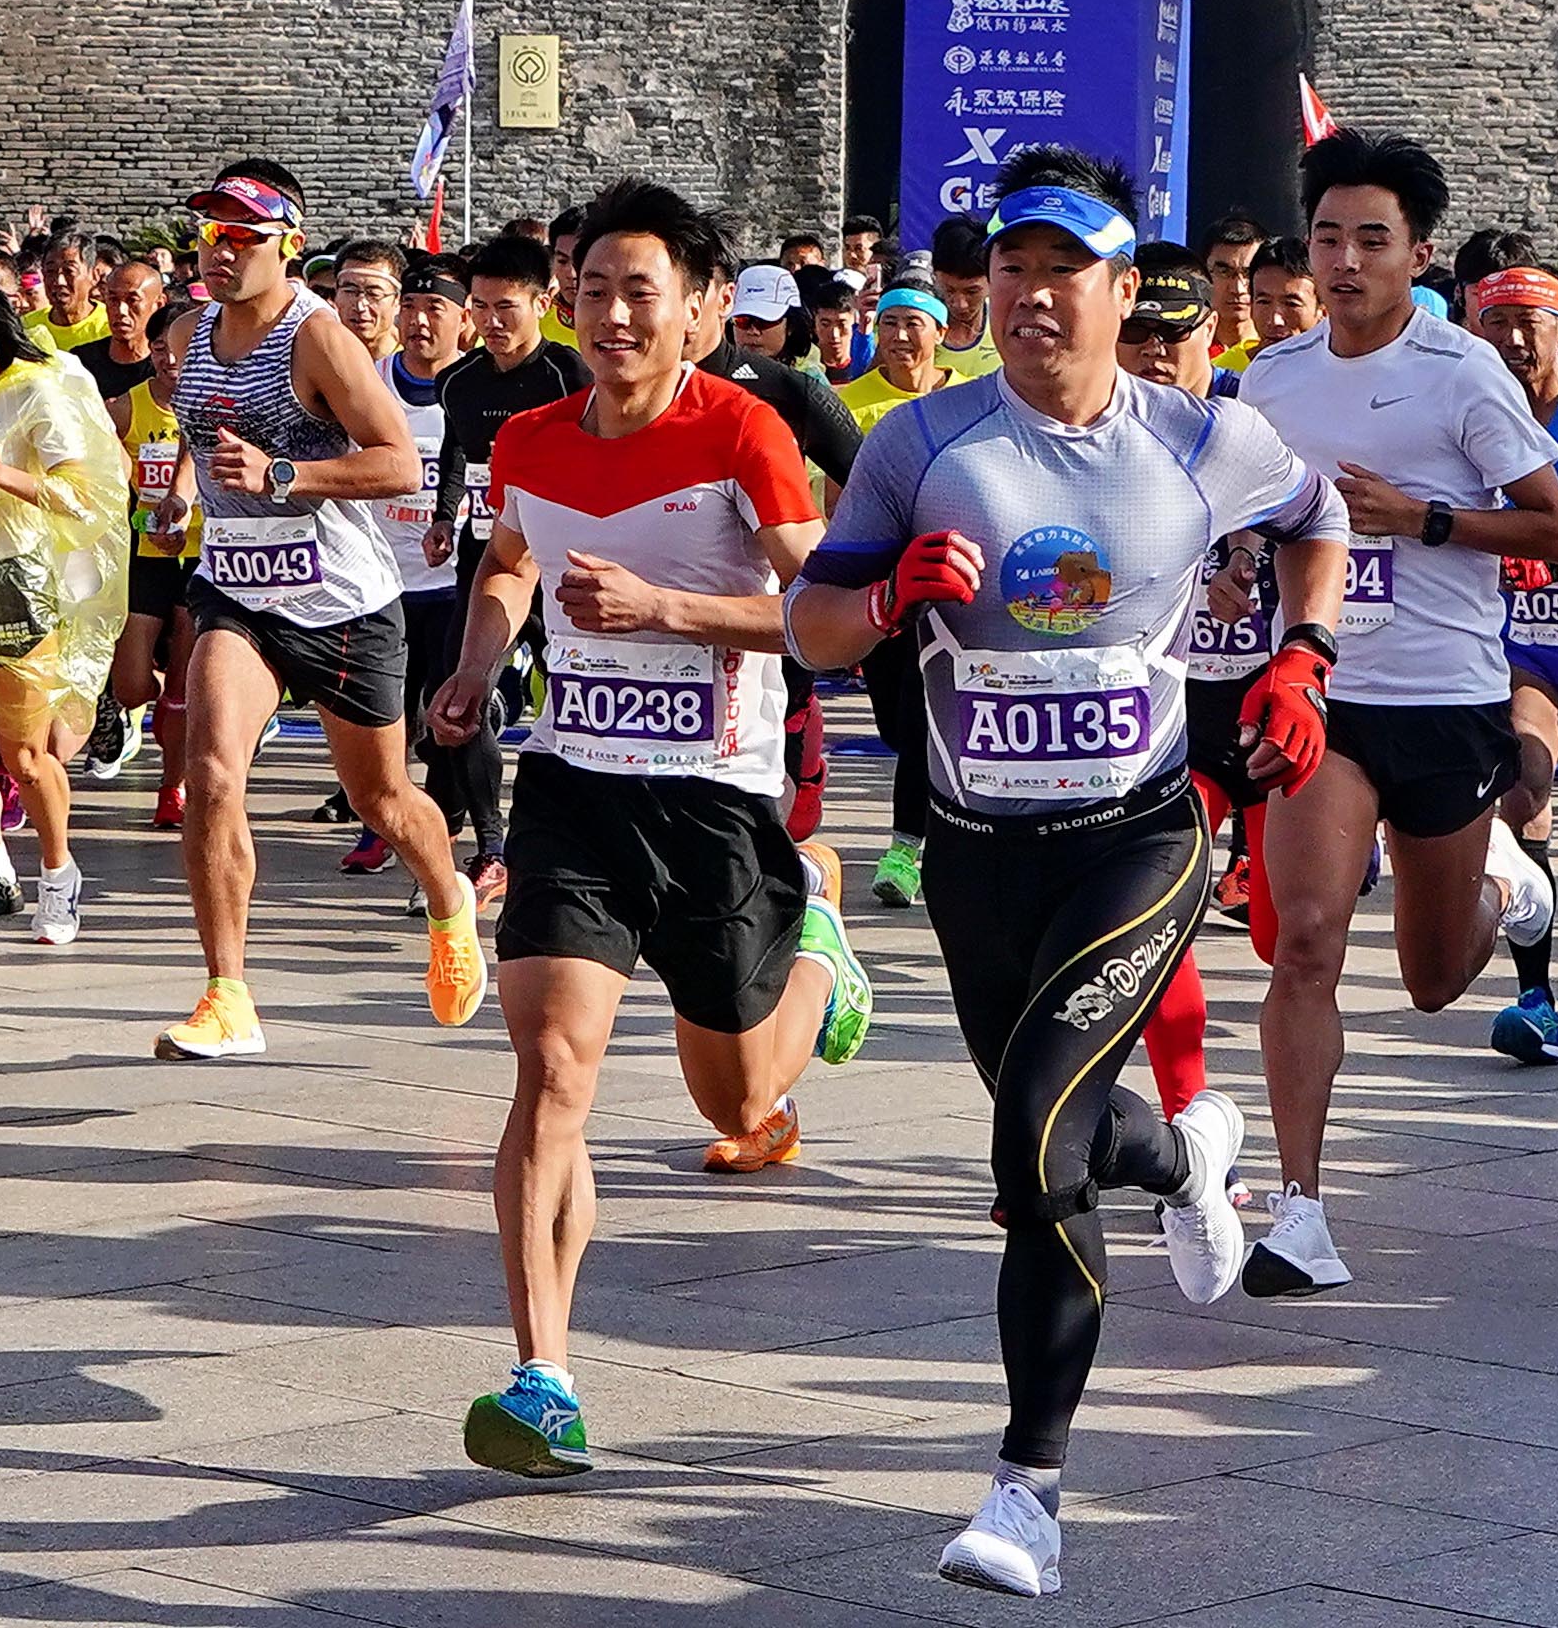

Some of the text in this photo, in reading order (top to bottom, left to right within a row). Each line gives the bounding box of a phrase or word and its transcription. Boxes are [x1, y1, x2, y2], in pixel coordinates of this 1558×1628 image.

[973, 89, 1066, 108] 永诚保险
[211, 547, 313, 584] A0043
[557, 680, 702, 735] A0238
[966, 696, 1141, 754] A0135
